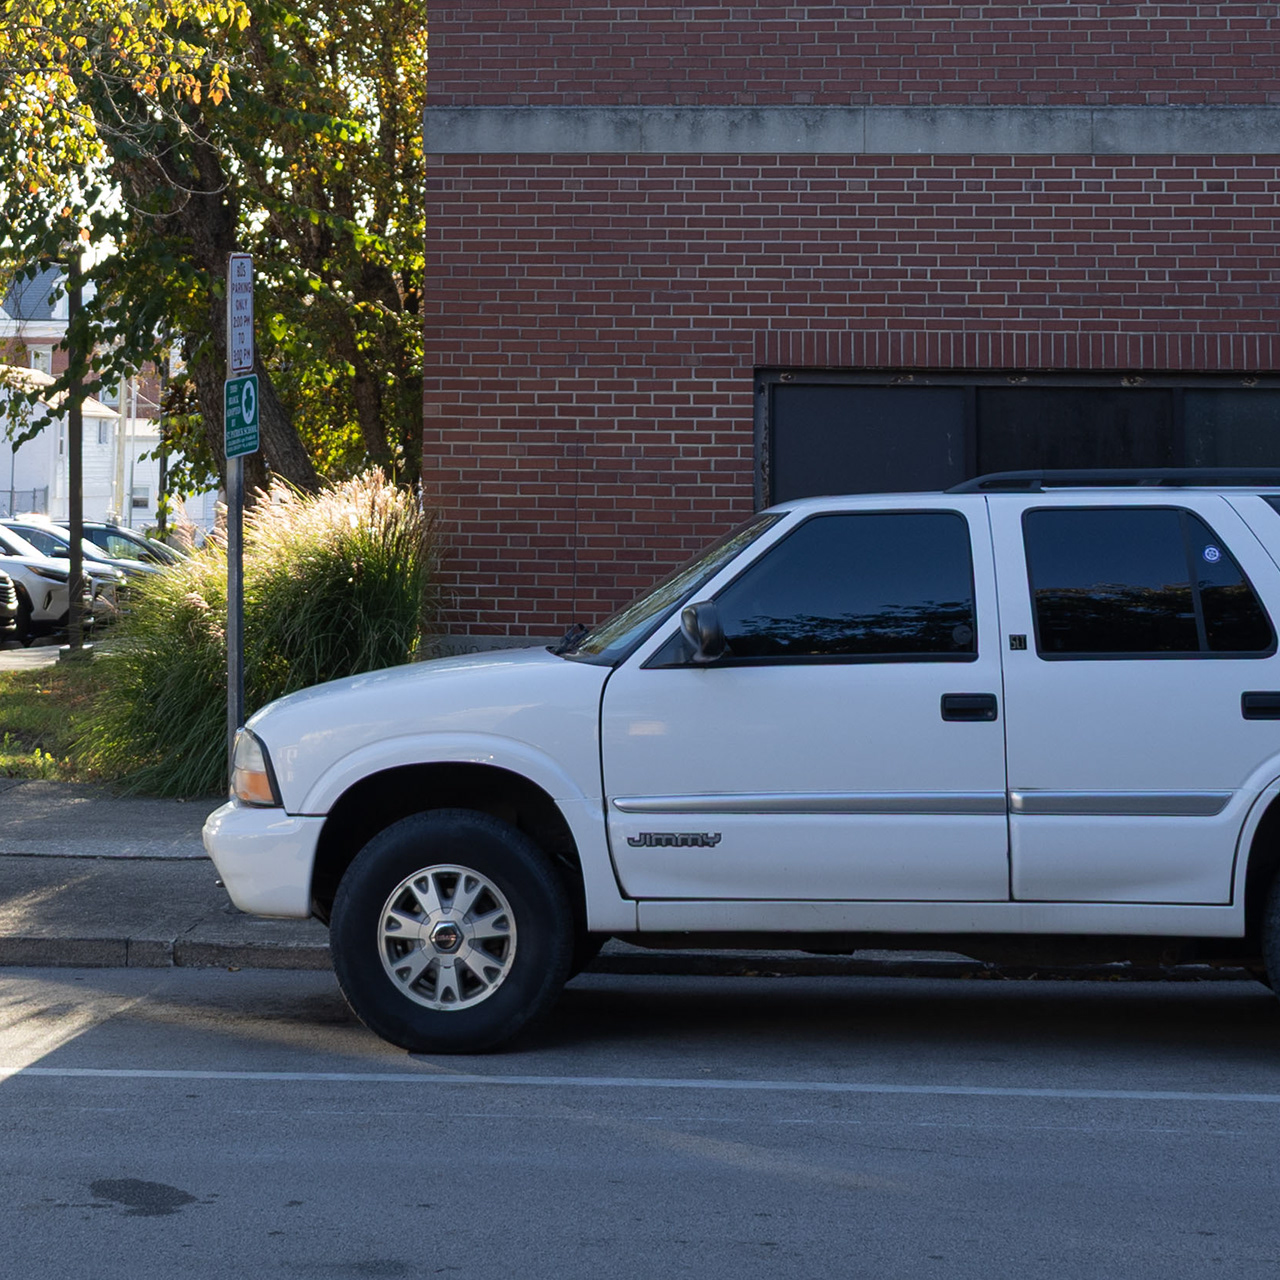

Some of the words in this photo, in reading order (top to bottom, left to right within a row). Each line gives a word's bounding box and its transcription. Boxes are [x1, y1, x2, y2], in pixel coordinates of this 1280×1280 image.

[236, 265, 246, 277] BUS
[232, 282, 252, 293] PARKING
[235, 299, 248, 311] ONLY
[243, 315, 251, 327] PM
[238, 332, 245, 344] TO
